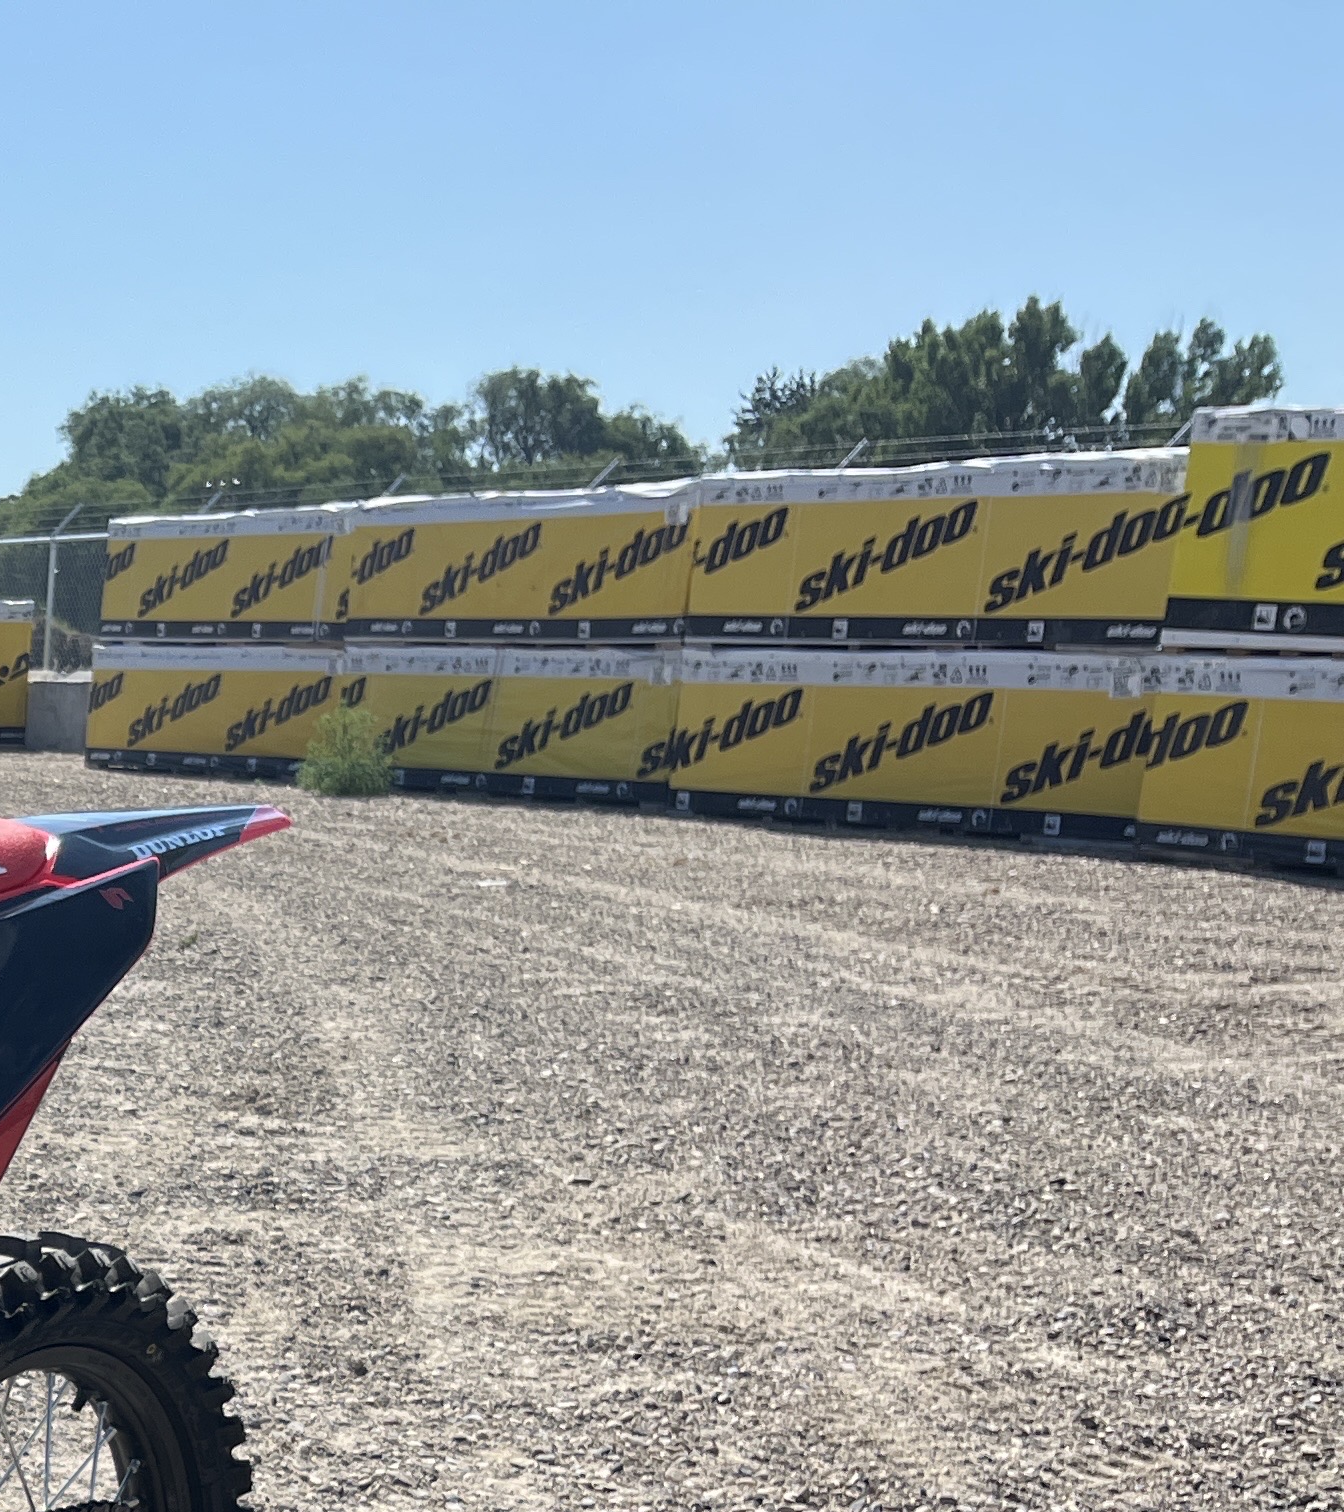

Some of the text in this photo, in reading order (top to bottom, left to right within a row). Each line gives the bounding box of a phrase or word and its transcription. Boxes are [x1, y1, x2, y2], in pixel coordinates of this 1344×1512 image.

[137, 539, 229, 618] ski-doo
[230, 535, 333, 618] ski-doo
[418, 521, 541, 615] ski-doo
[548, 516, 691, 615] ski-doo
[794, 499, 978, 612] ski-doo
[984, 492, 1192, 613] ski-doo
[127, 673, 222, 747] ski-doo
[225, 676, 333, 751] ski-doo
[495, 682, 633, 770] ski-doo
[810, 691, 994, 794] ski-doo
